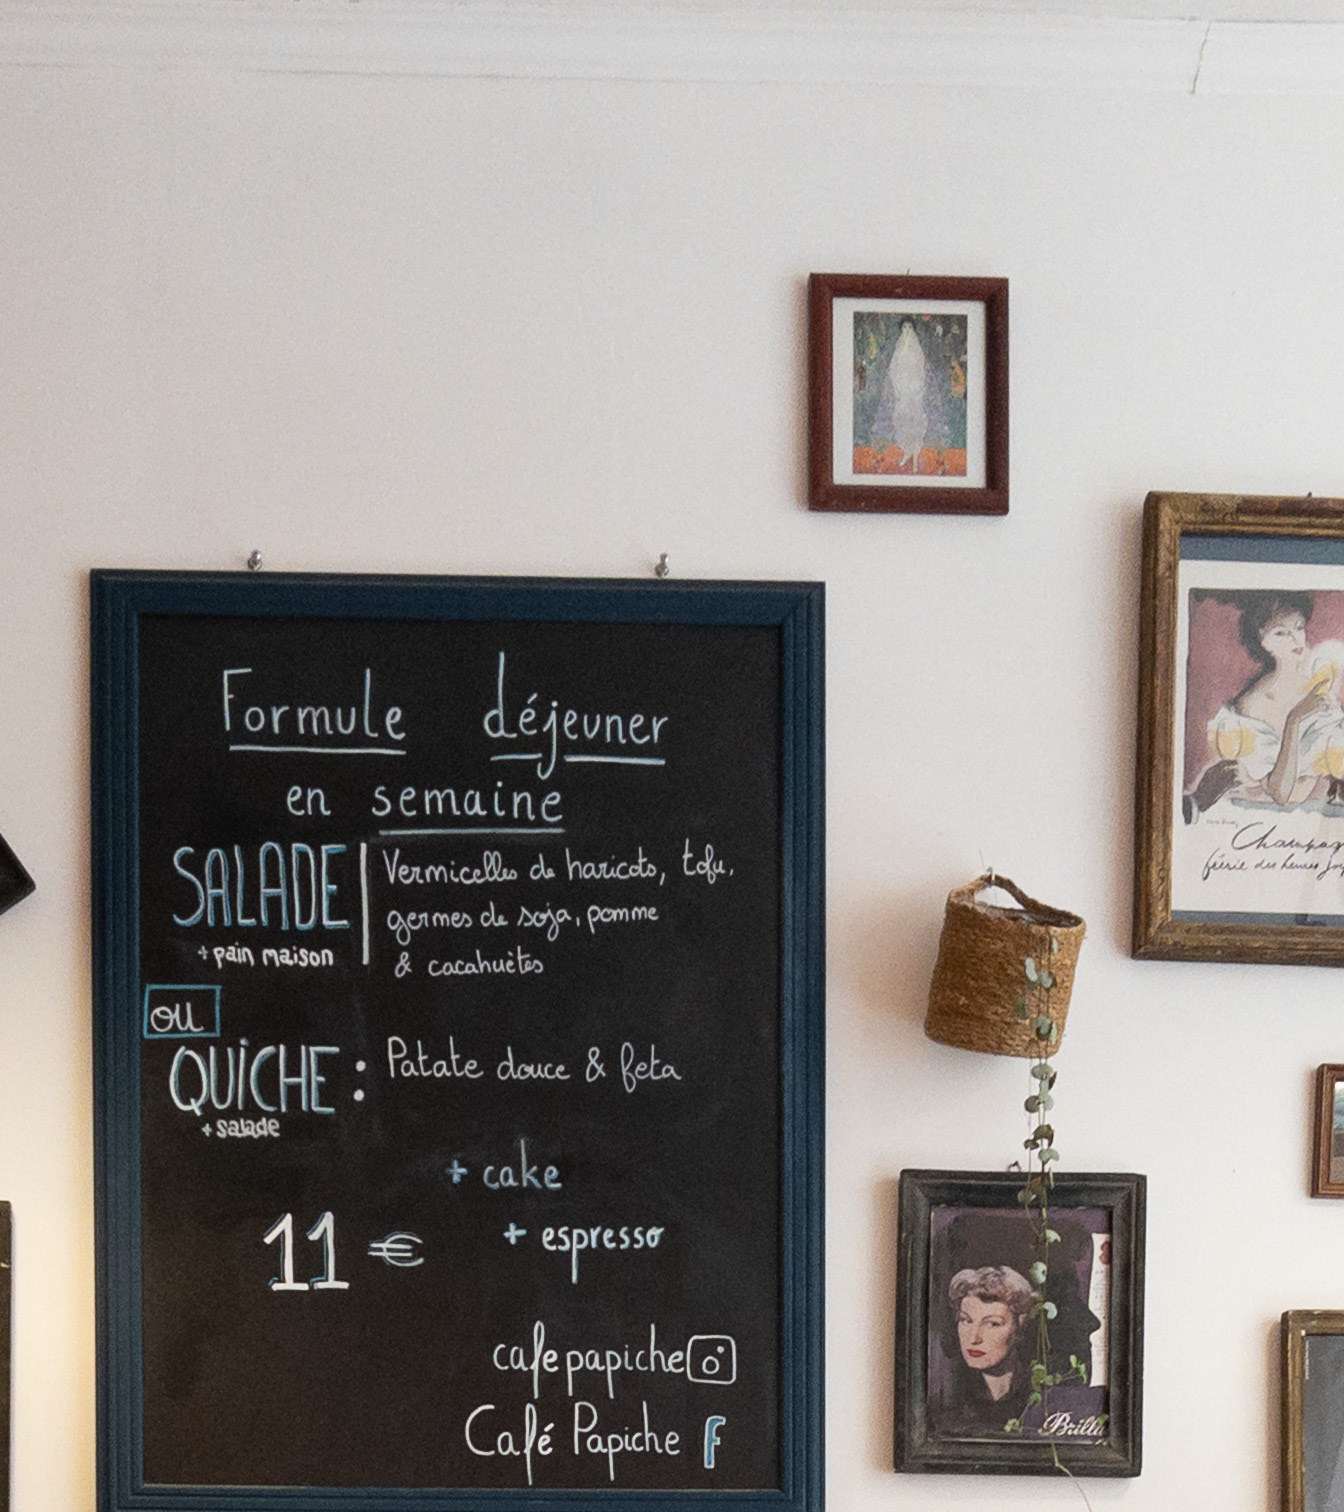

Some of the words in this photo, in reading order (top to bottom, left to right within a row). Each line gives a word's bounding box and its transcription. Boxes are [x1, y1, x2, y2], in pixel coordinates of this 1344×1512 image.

[222, 668, 407, 740] Formule
[483, 651, 669, 780] déjeuner
[287, 781, 332, 817] en
[371, 782, 564, 823] semaine
[172, 842, 350, 931] SALADE
[382, 848, 518, 885] Vermicelles
[529, 853, 556, 880] de
[565, 847, 666, 886] haricots,
[387, 905, 473, 946] germes
[480, 901, 509, 928] de
[517, 902, 581, 942] soja,
[587, 904, 660, 935] pomme
[212, 941, 256, 969] pain
[262, 945, 334, 968] maison
[394, 951, 412, 978] &
[427, 945, 545, 977] cacahuètes
[150, 1002, 205, 1032] ou
[387, 1034, 484, 1078] Patate
[496, 1045, 571, 1080] douce
[585, 1046, 607, 1083] &
[620, 1042, 683, 1093] feta
[215, 1116, 281, 1139] salade
[445, 1159, 468, 1184] +
[482, 1138, 563, 1190] cake
[263, 1211, 350, 1292] 11
[367, 1230, 425, 1268] €
[503, 1222, 528, 1245] +
[542, 1225, 665, 1285] espresso
[464, 1402, 555, 1486] Café
[572, 1400, 682, 1482] Papiche
